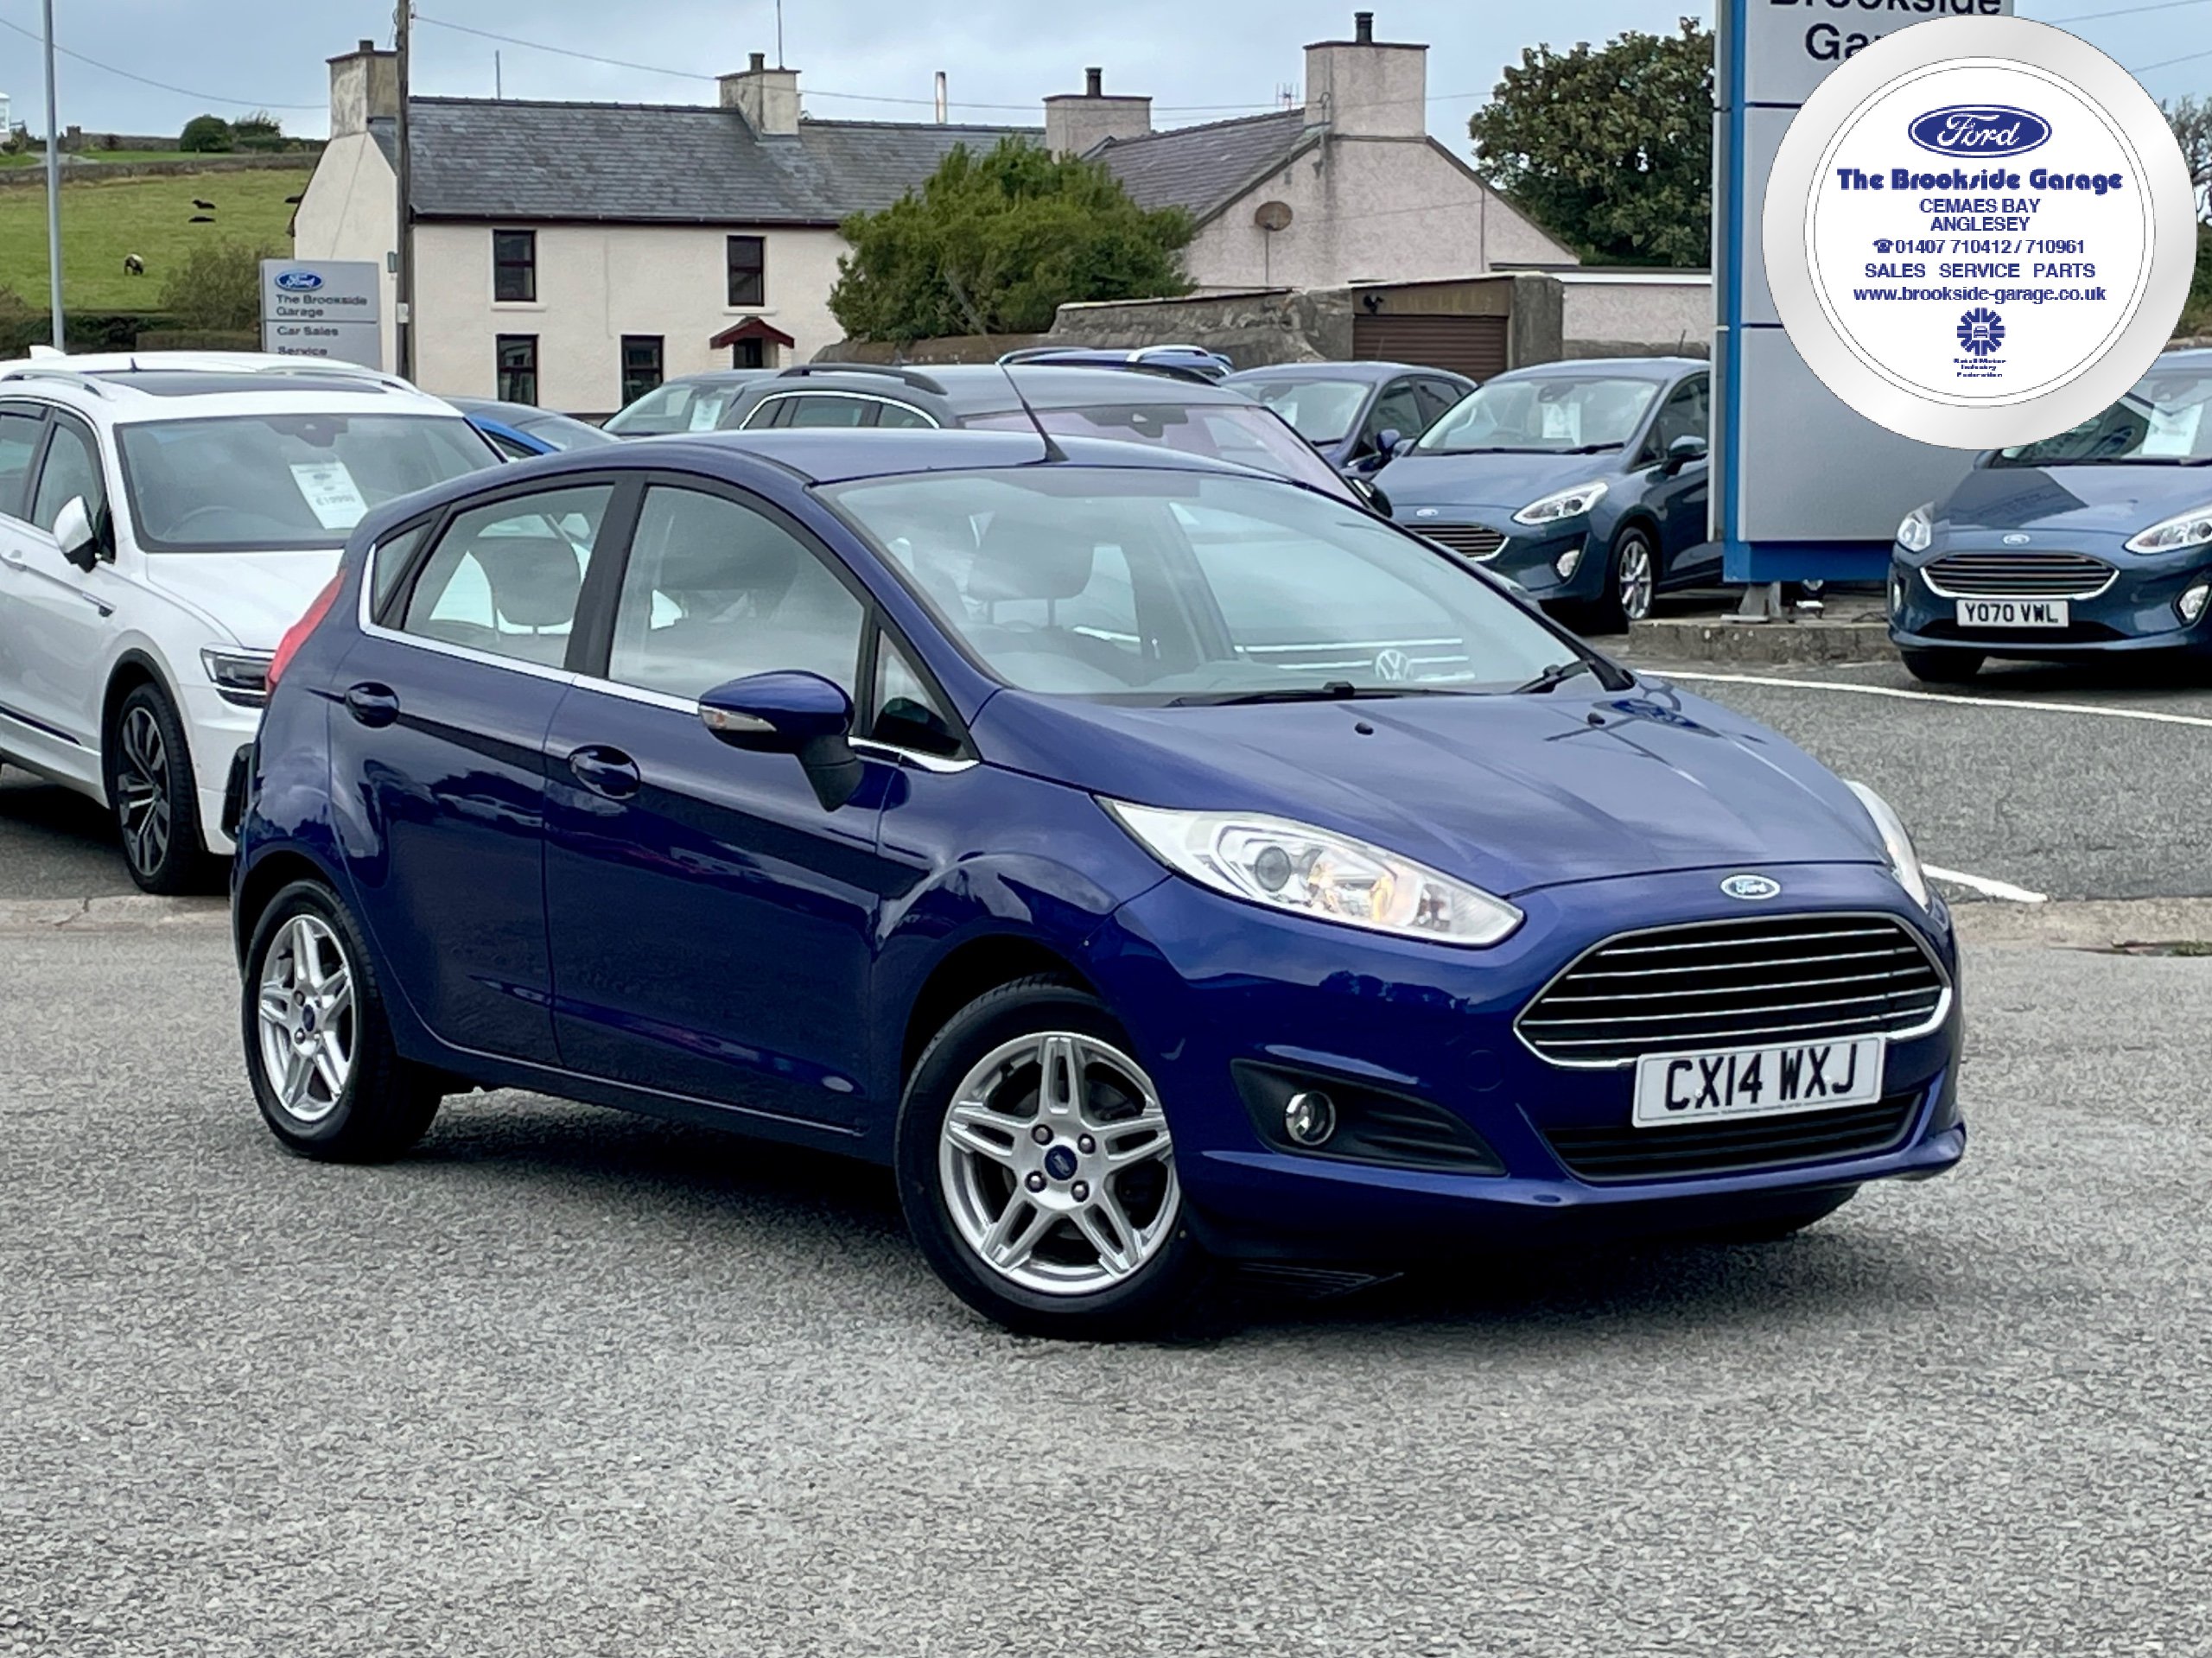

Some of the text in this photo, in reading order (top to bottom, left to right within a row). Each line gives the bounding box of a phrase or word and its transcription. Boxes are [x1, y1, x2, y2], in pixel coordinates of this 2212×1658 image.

[1805, 22, 1883, 60] Ga
[276, 294, 368, 306] The Brookside
[276, 307, 324, 318] Garage
[276, 327, 339, 337] Car Sales
[2020, 604, 2058, 623] VWL
[1665, 1043, 1857, 1110] CX14 WXJ
